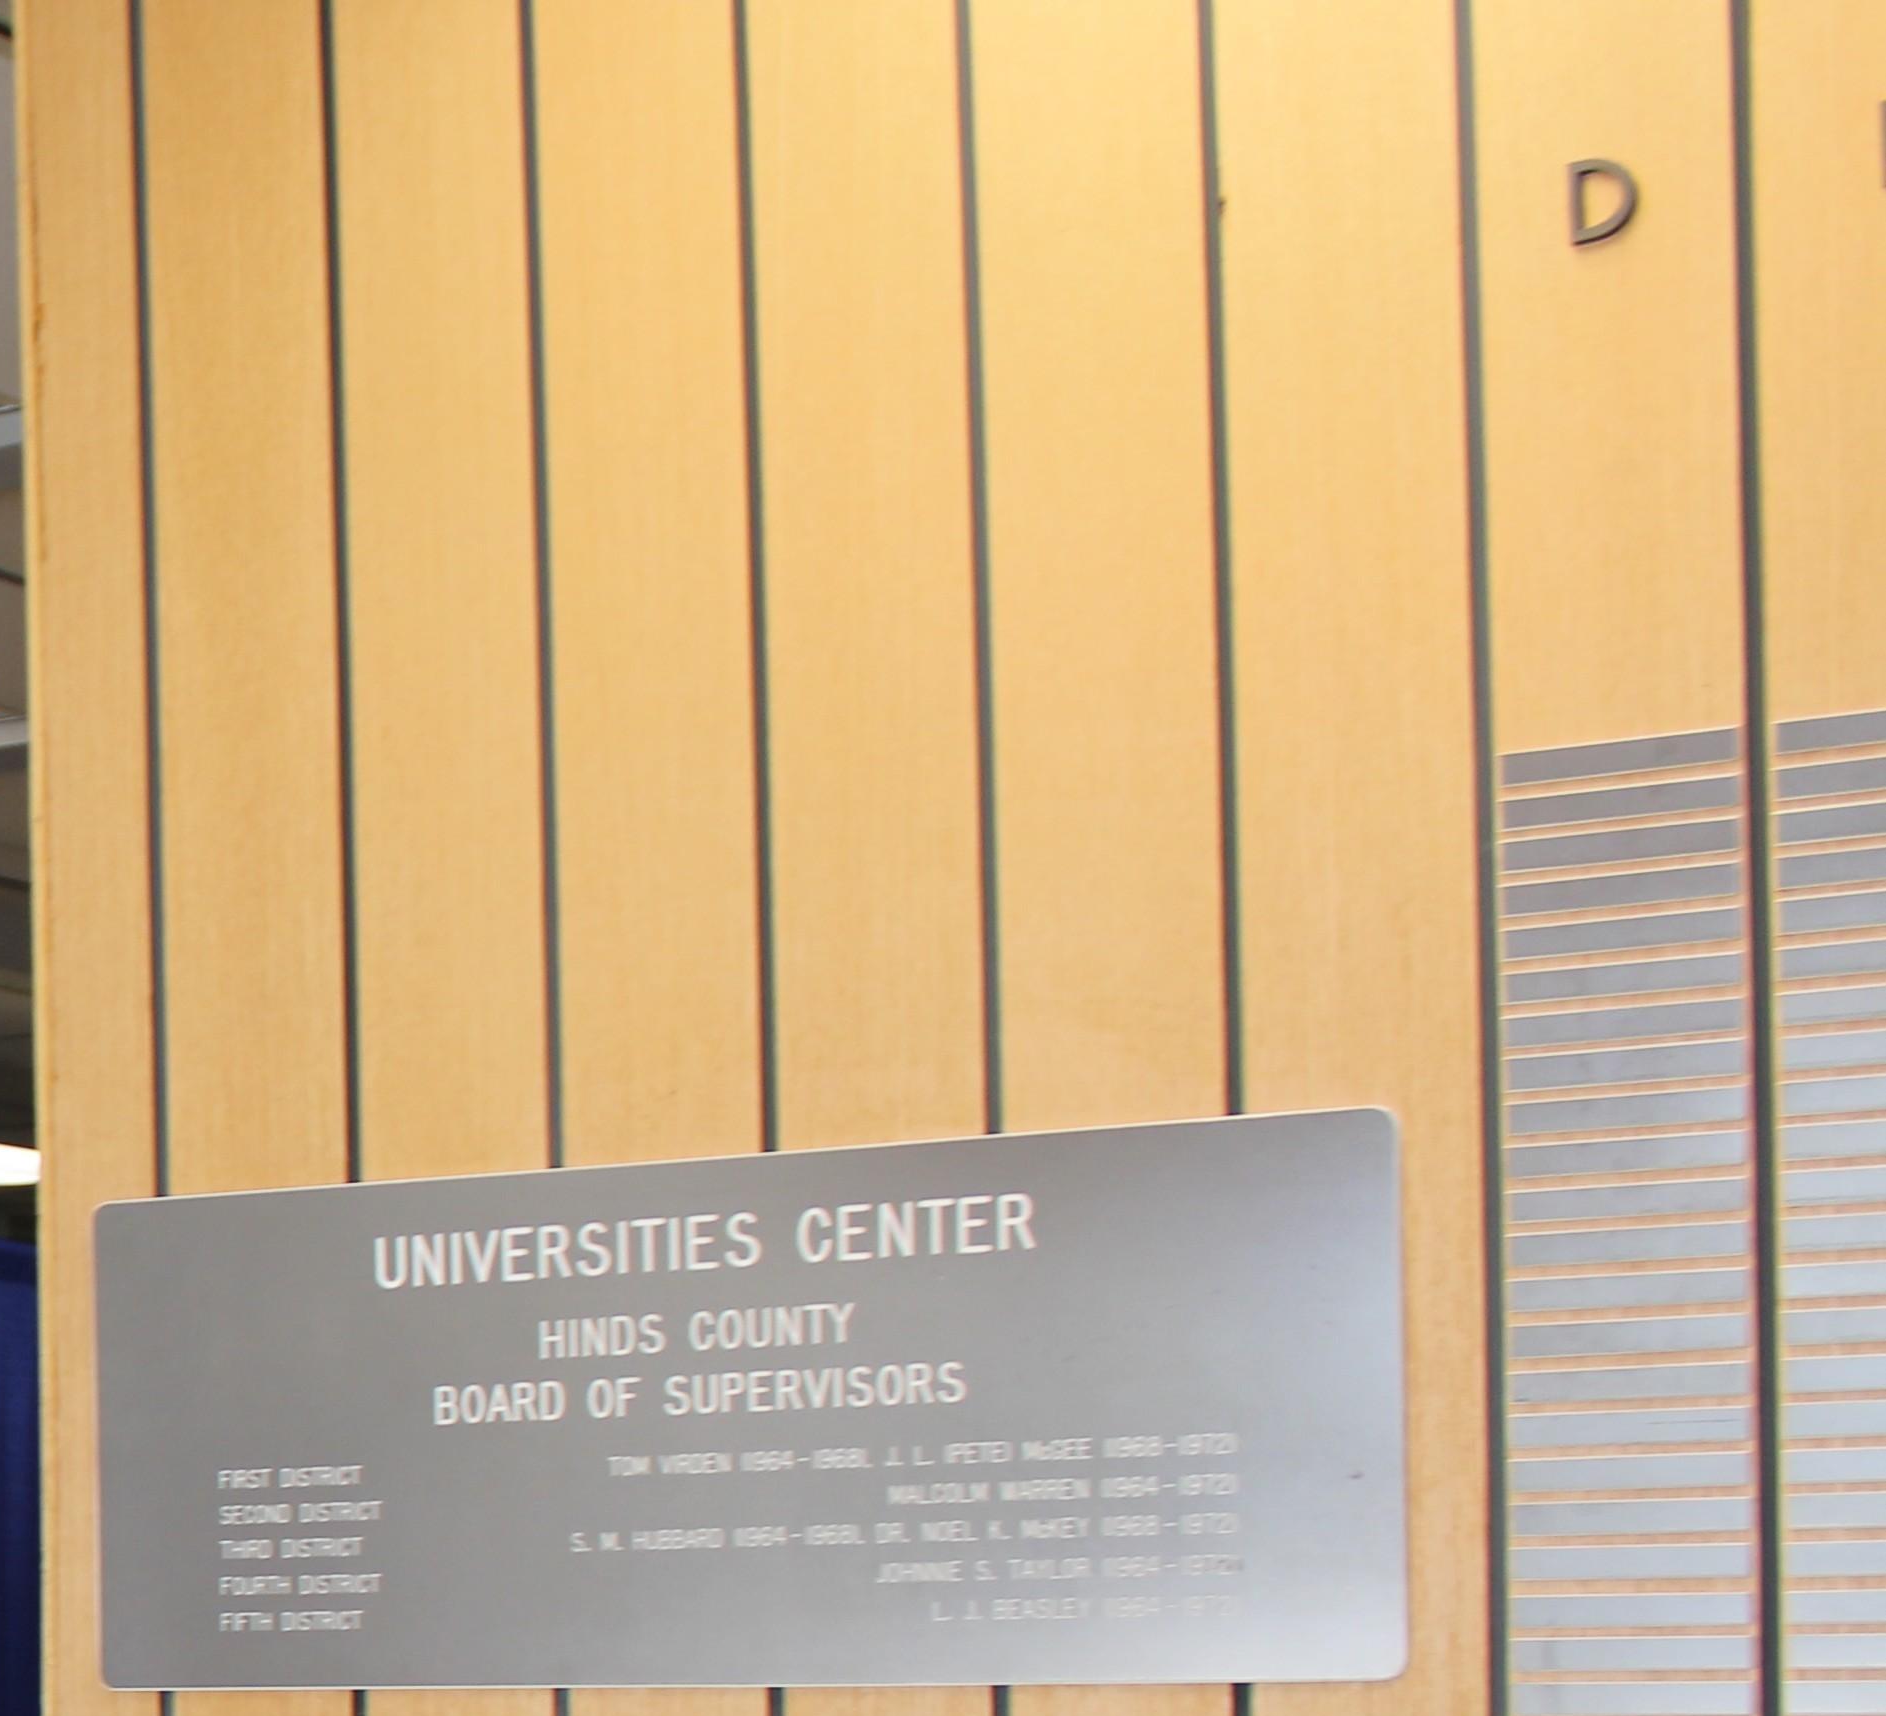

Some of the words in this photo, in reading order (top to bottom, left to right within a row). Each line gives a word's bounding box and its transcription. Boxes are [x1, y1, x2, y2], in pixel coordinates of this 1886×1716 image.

[1566, 157, 1639, 247] D
[373, 1211, 763, 1290] UNIVERSITIES
[795, 1192, 1038, 1264] CENTER
[536, 1312, 667, 1360] HINDS
[687, 1302, 856, 1351] COUNTY
[432, 1379, 568, 1426] BOARD
[585, 1375, 643, 1419] OF
[661, 1360, 968, 1416] SUPERVISORS
[217, 1467, 273, 1489] FIRST
[279, 1464, 365, 1488] DISTRICT
[885, 1481, 991, 1505] MALCOLM
[218, 1502, 293, 1526] SECOND
[297, 1499, 384, 1524] DISTRICT
[217, 1537, 274, 1560] THIRD
[279, 1535, 365, 1559] DISTRICT
[218, 1574, 293, 1596] FOURTH
[297, 1572, 384, 1595] DISTRICT
[218, 1611, 274, 1632] FIFTH
[279, 1609, 365, 1631] DISTRICT
